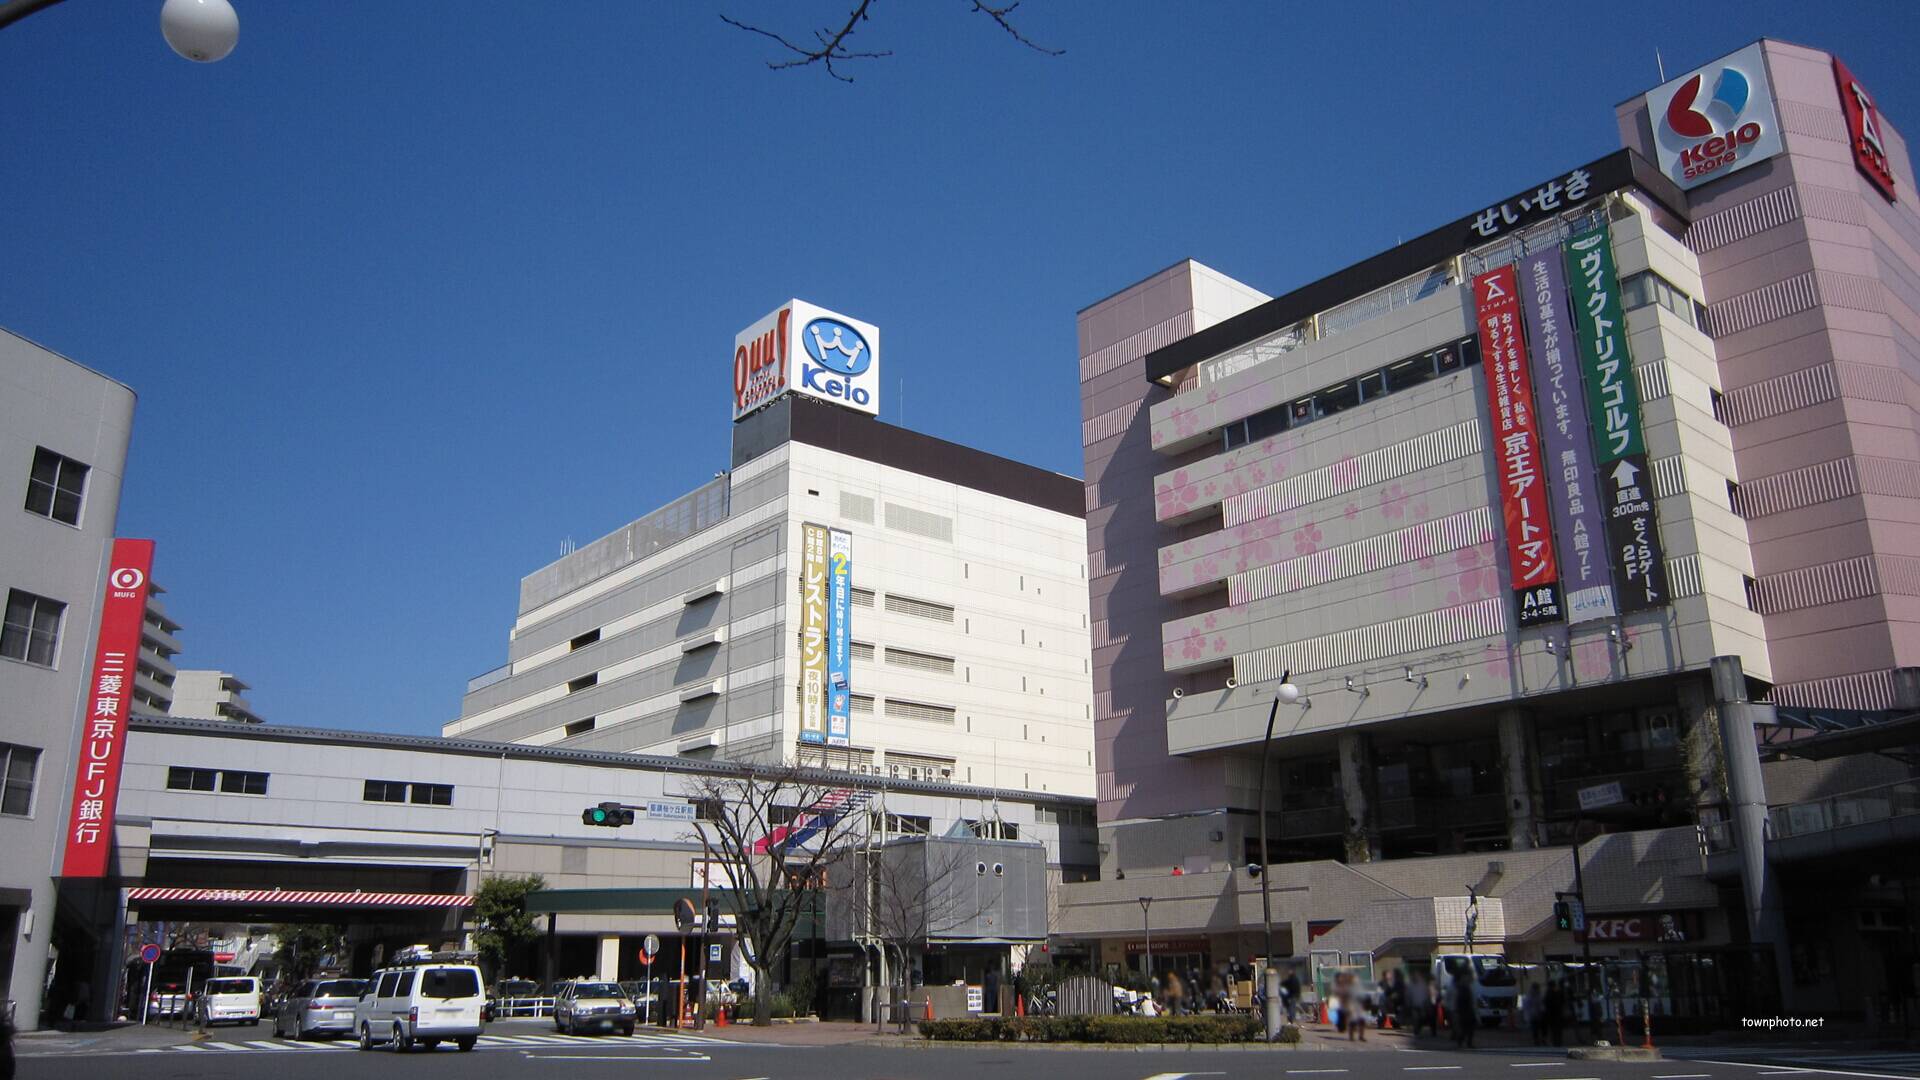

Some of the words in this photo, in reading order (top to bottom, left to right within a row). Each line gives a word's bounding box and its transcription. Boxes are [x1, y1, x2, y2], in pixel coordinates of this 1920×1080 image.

[1684, 152, 1738, 181] store
[1471, 169, 1591, 236] せいせき
[1533, 260, 1573, 440] 生活の基本が揃っています。
[1580, 248, 1630, 456] ヴィクトリアゴルフ
[802, 363, 870, 405] Keio
[1502, 431, 1545, 581] 京王アートマン
[1561, 450, 1584, 515] 無印良品
[1573, 519, 1592, 581] A館7F
[1612, 502, 1649, 518] 300m先
[1616, 487, 1641, 505] 直進
[1623, 545, 1637, 580] 2F
[1632, 517, 1658, 602] さくらゲート
[113, 591, 136, 599] MUFG
[805, 563, 822, 667] レストラン
[1524, 588, 1552, 609] A館
[75, 652, 126, 844] 三菱東京UFJ銀行
[1588, 919, 1641, 939] KFC
